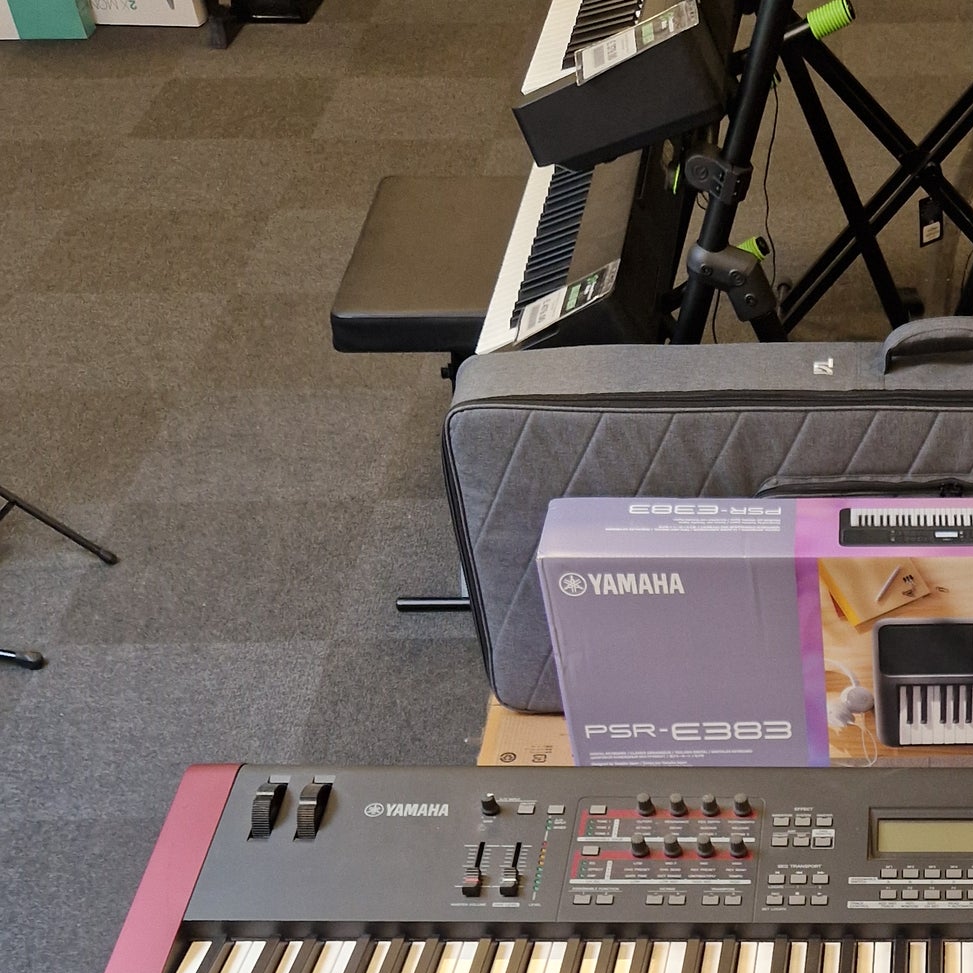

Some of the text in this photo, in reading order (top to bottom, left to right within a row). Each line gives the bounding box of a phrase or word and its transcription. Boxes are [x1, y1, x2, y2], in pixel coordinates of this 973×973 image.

[628, 503, 782, 515] PSR-E383
[587, 572, 686, 596] YAMAHA
[584, 720, 793, 742] PSR-E383
[386, 803, 449, 817] YAMAHA
